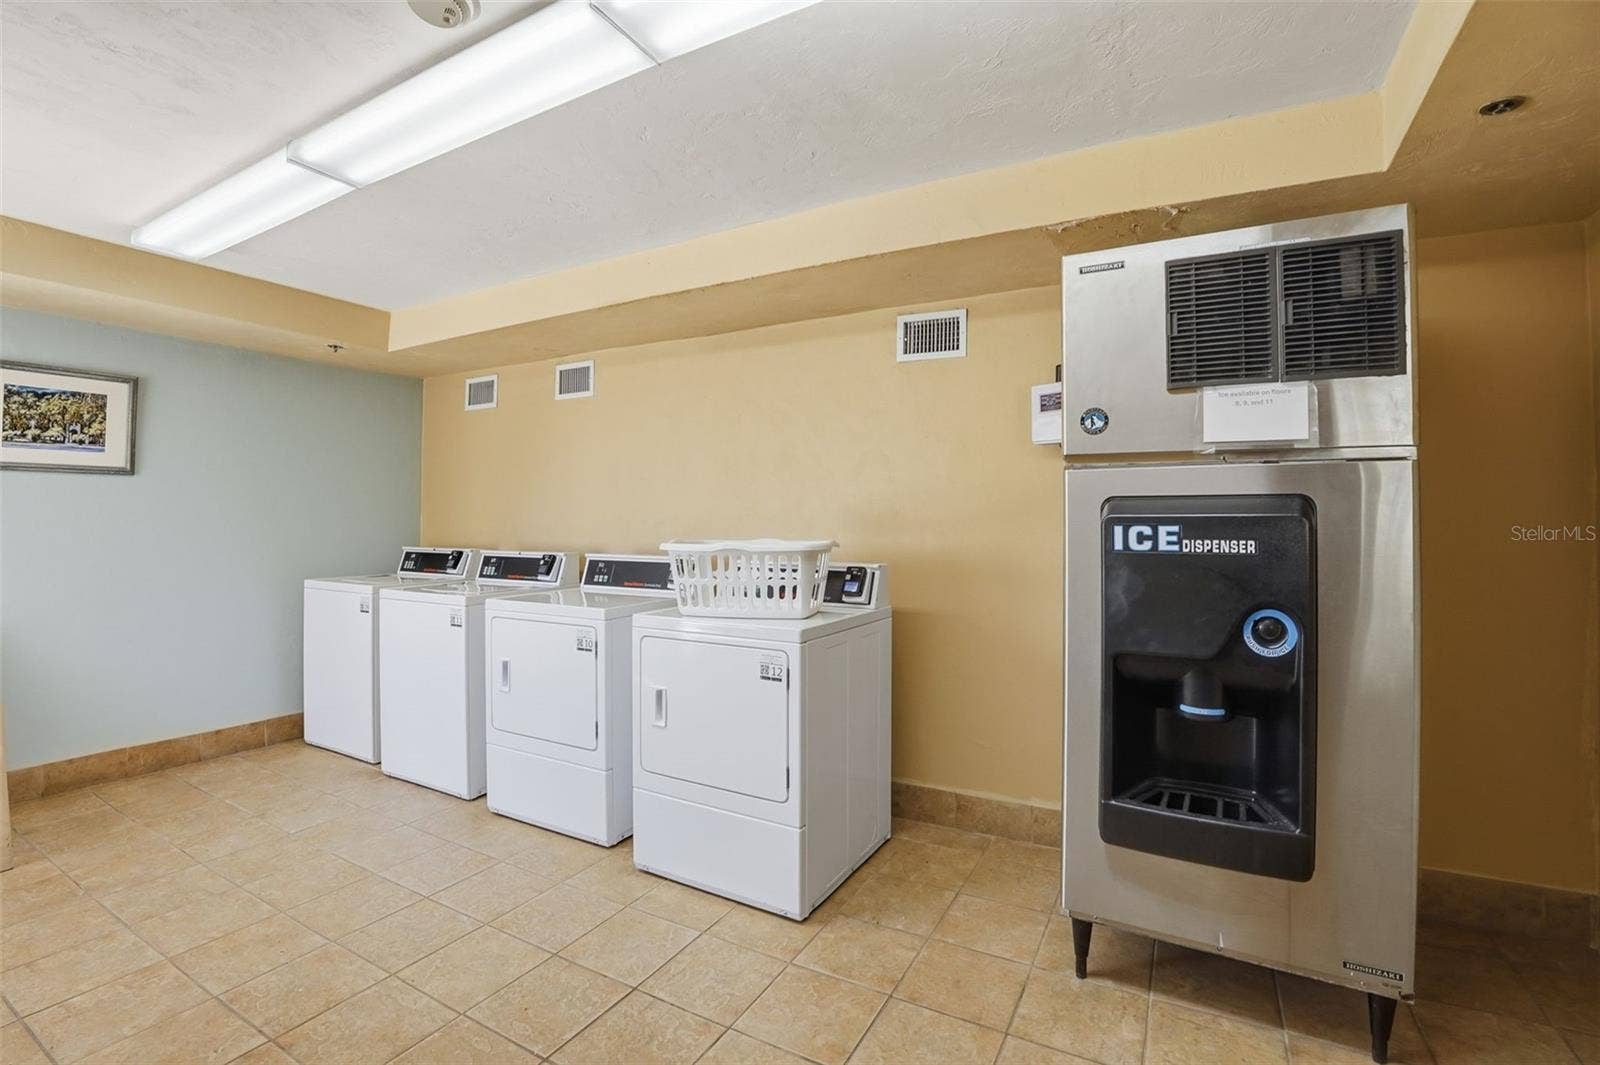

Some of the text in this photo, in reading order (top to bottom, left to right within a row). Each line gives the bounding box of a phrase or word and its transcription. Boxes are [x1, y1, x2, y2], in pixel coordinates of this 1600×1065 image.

[1113, 525, 1256, 554] ICE DISPENSER
[585, 639, 593, 648] 10
[772, 666, 783, 677] 12
